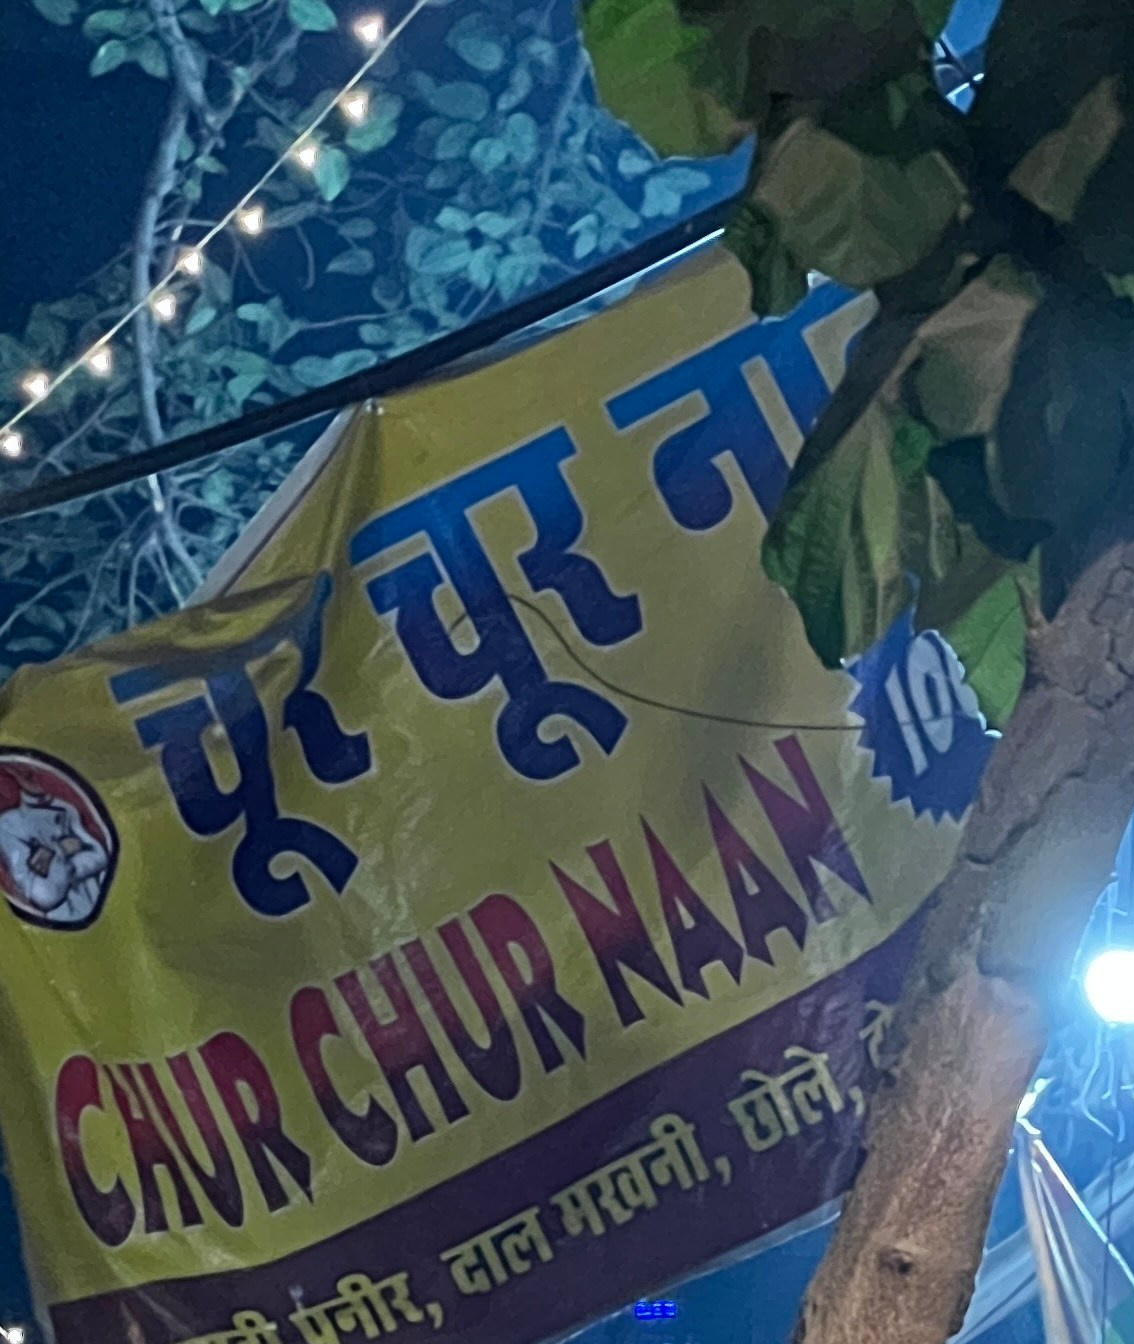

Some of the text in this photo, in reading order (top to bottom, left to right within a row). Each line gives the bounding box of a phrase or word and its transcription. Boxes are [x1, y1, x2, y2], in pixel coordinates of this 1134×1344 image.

[108, 279, 862, 917] चूर चूर ना
[54, 735, 874, 1248] CHUR CHUR NAAN
[439, 1205, 555, 1295] दाल
[727, 1045, 866, 1152] छोले,
